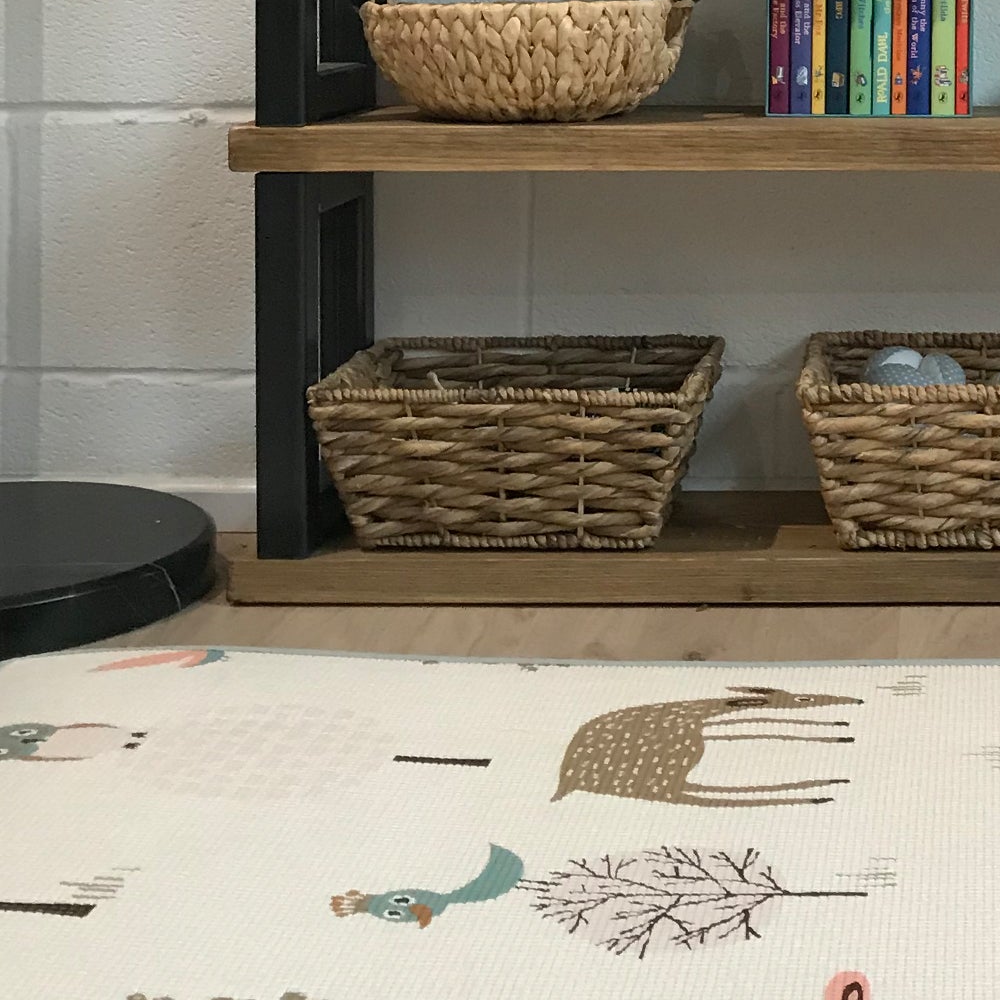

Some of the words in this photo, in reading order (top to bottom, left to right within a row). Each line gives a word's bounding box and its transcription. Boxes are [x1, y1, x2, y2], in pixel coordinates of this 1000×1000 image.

[780, 3, 788, 18] and
[803, 3, 811, 19] and
[911, 5, 919, 14] of
[794, 10, 803, 45] Elevator
[803, 21, 811, 36] the
[911, 16, 919, 30] the
[919, 18, 927, 32] the
[877, 32, 888, 62] DAHL
[877, 67, 887, 103] ROALD
